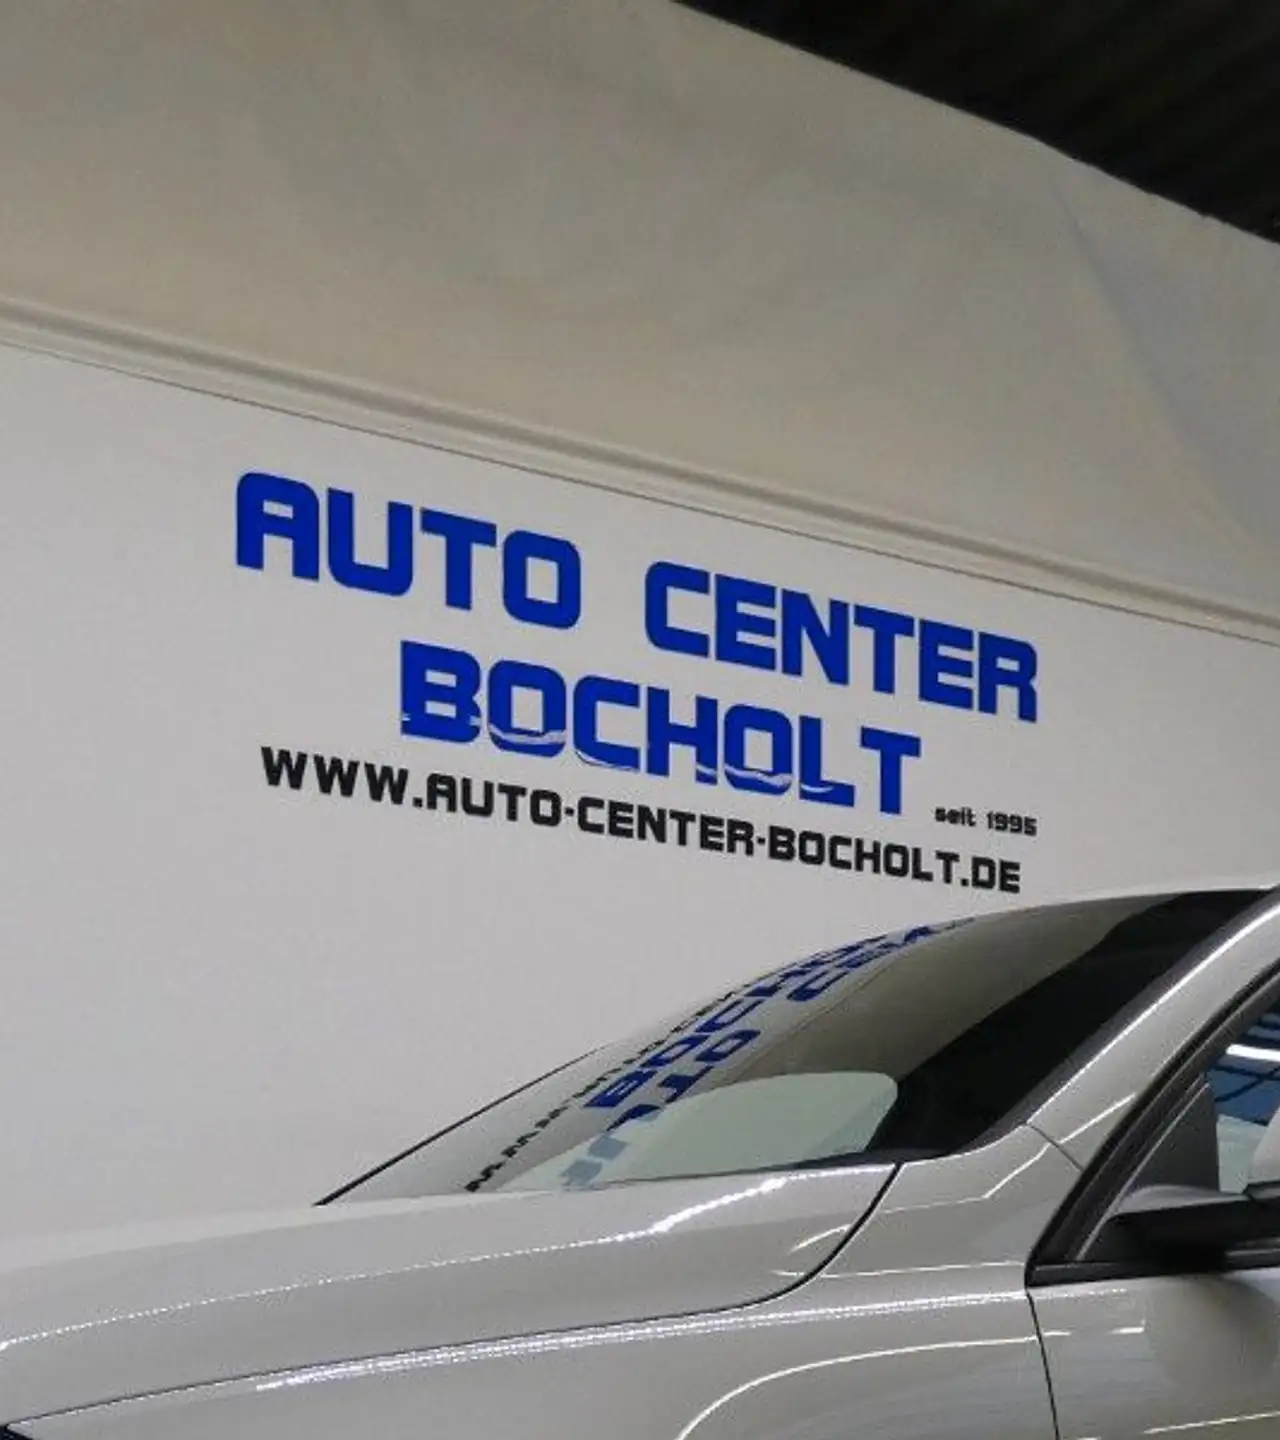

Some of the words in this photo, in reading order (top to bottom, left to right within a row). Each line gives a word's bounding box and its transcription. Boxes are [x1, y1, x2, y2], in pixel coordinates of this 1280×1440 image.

[236, 471, 582, 629] AUTO
[645, 561, 1038, 723] CENTER
[400, 640, 922, 816] BOCHOLT
[261, 746, 1021, 894] WWW.AUTO-CENTER-BOCHOLT.DE
[934, 807, 977, 827] seit
[986, 811, 1037, 837] 1995
